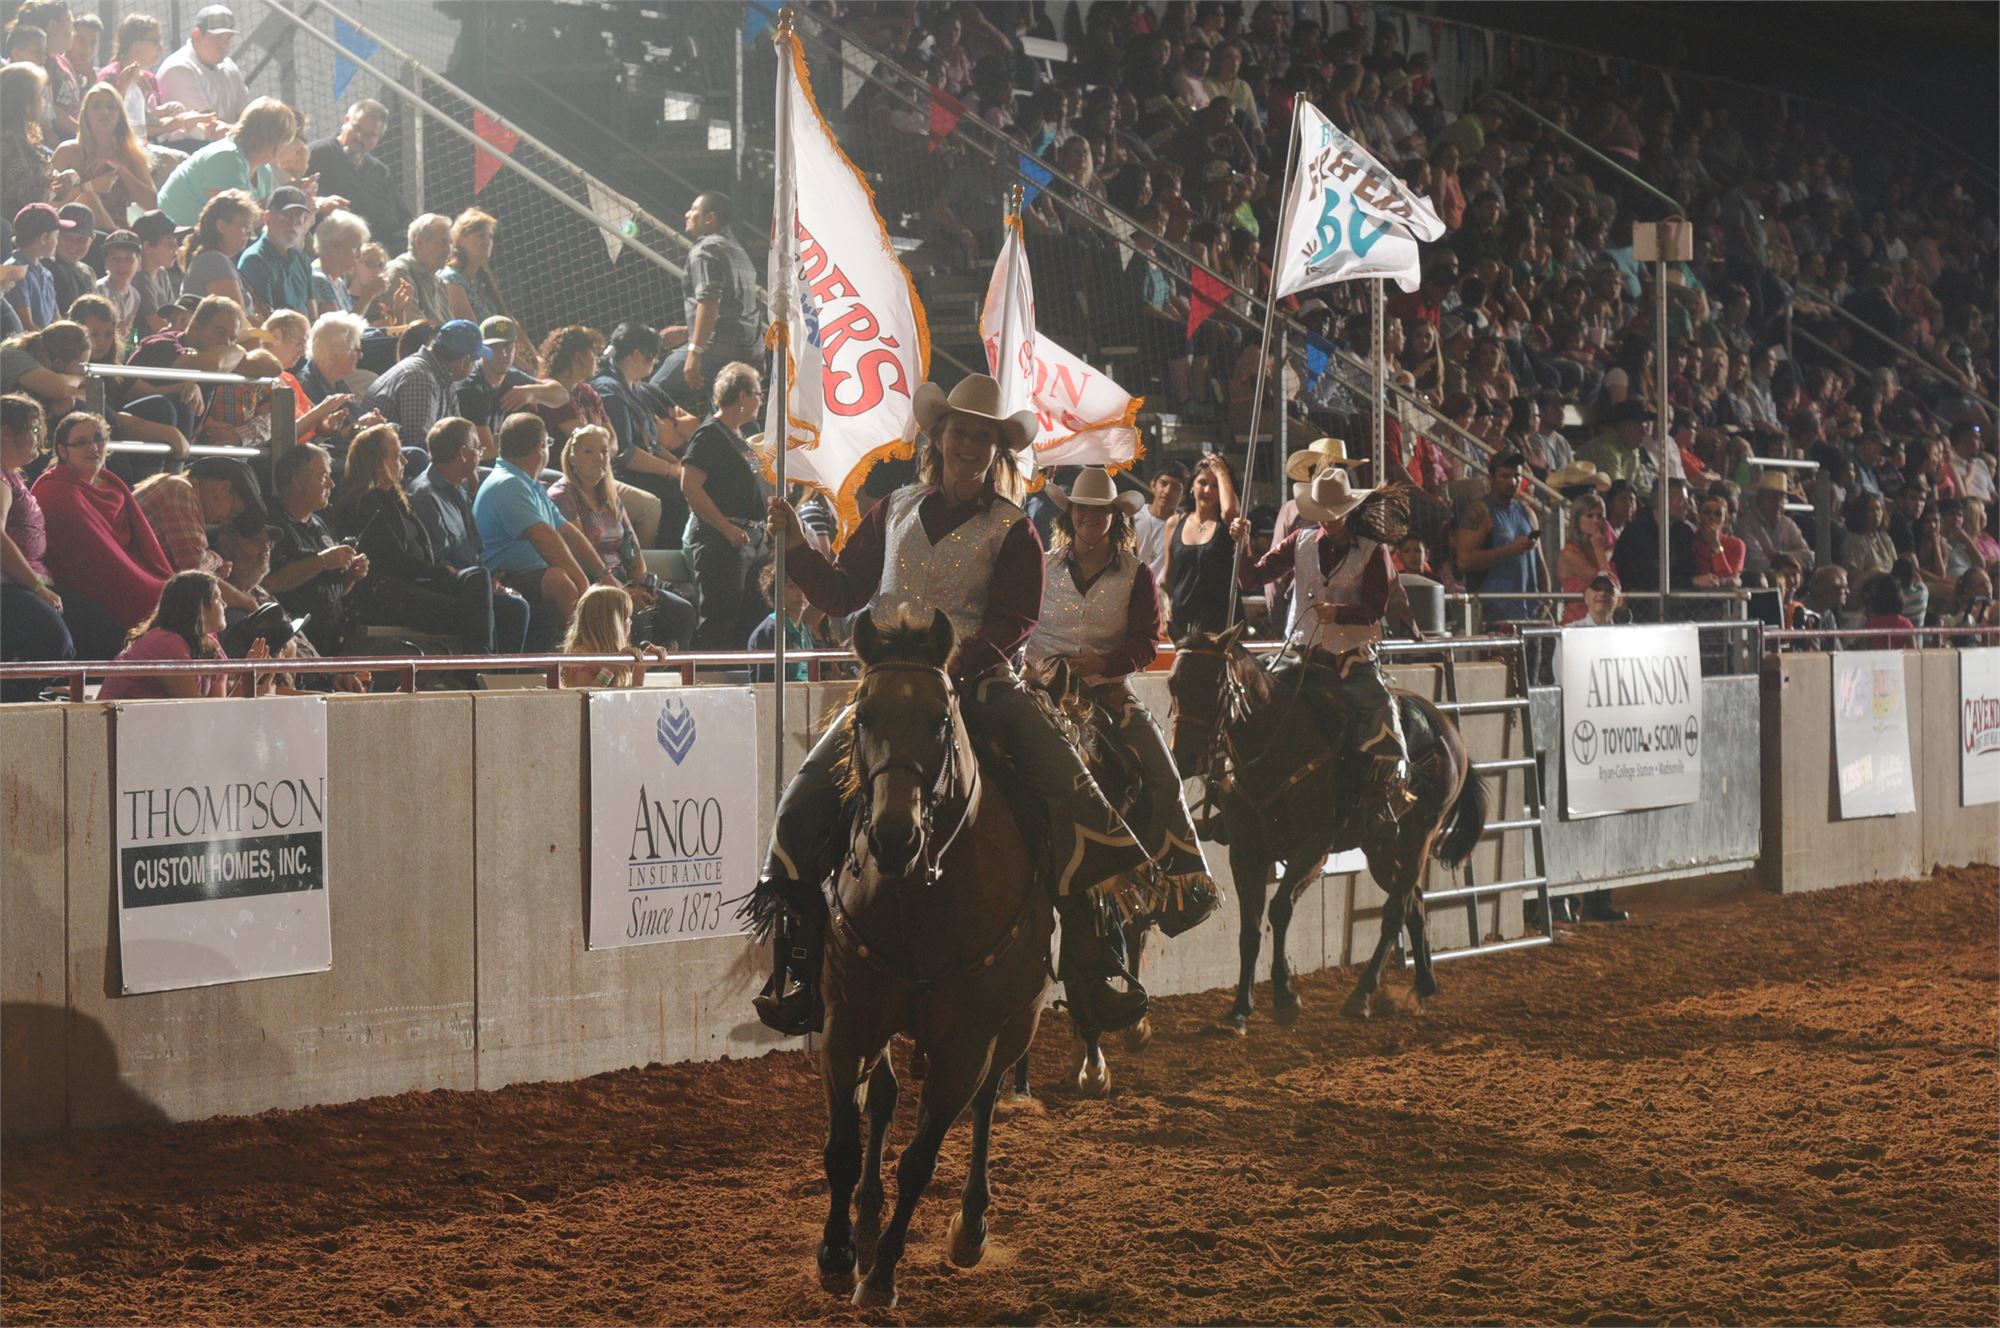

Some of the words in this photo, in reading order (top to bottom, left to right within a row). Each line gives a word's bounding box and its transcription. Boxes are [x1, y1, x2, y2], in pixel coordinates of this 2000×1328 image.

[799, 222, 911, 416] DER'S
[1586, 655, 1690, 707] ATKINSON
[1602, 726, 1646, 754] TOYOTA
[1655, 724, 1682, 751] SCION
[123, 777, 324, 840] THOMPSON
[628, 783, 723, 860] ANCO
[134, 854, 206, 890] CUSTOM
[211, 848, 275, 882] HOMES,
[279, 845, 312, 876] INC.
[628, 861, 723, 887] INSURANCE
[626, 895, 674, 939] Since
[678, 890, 723, 933] 1873
